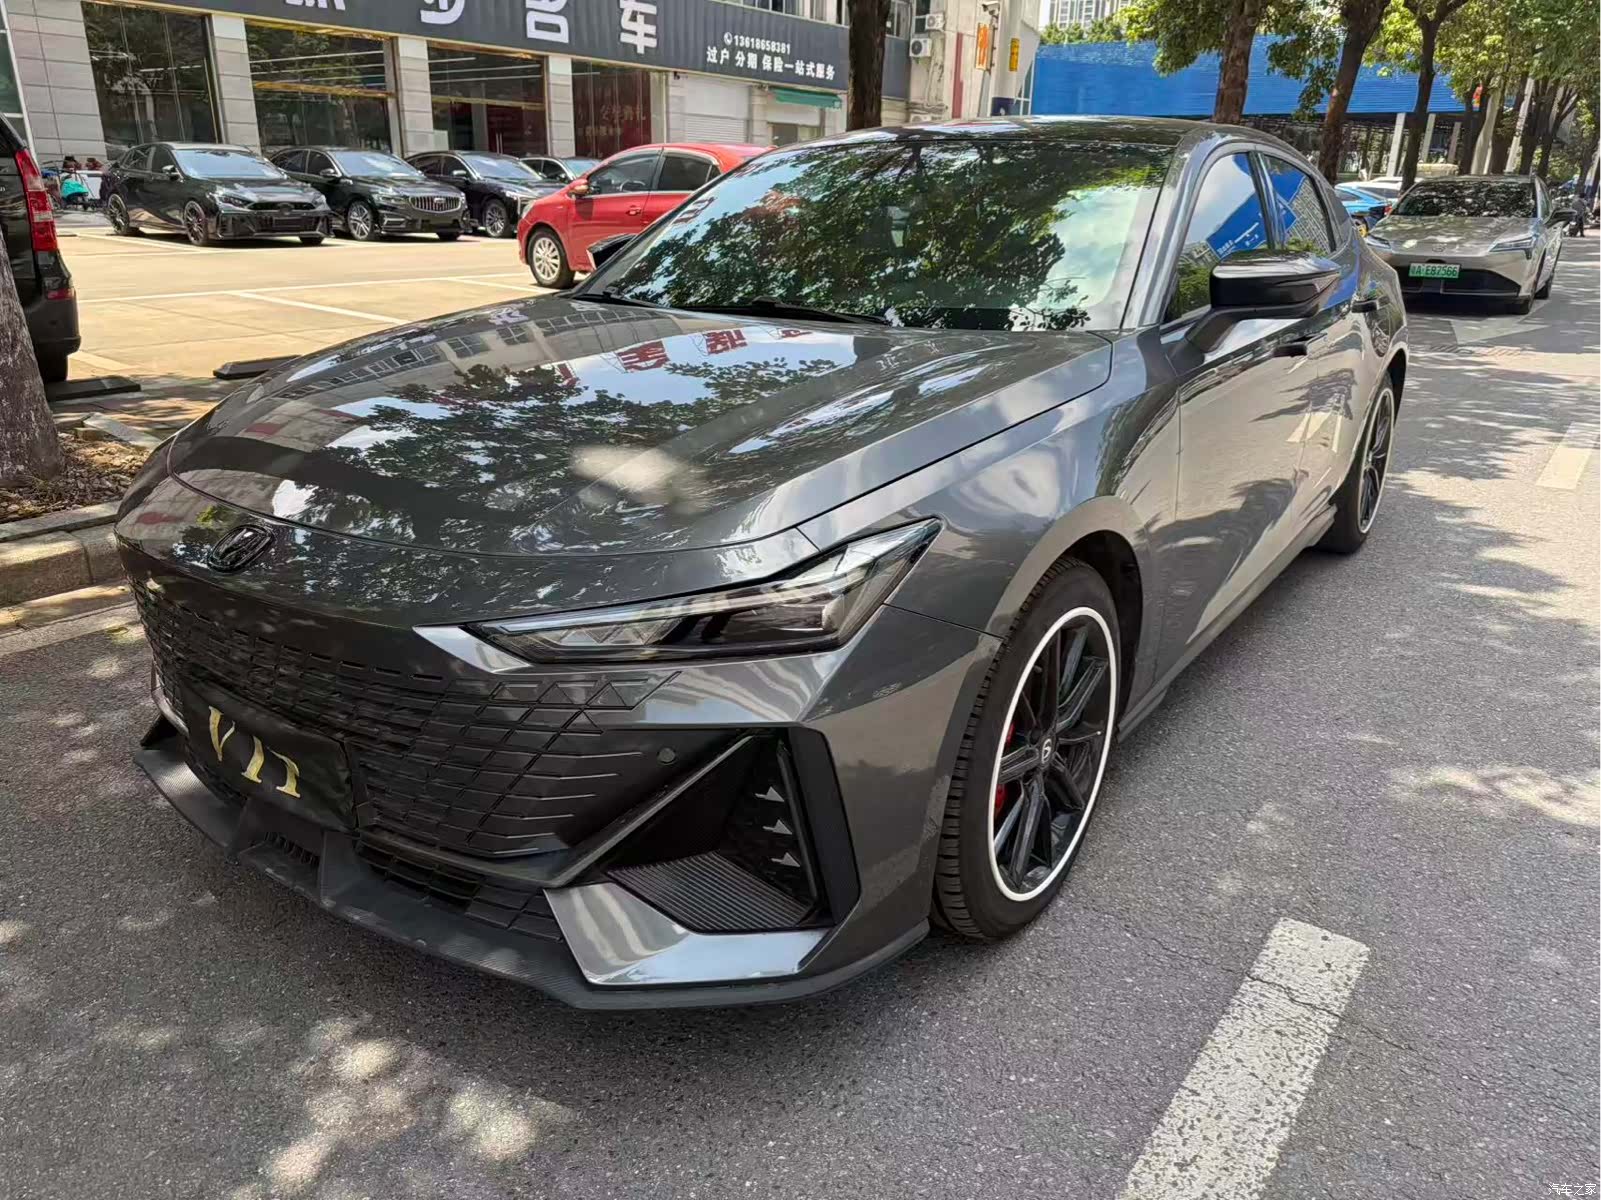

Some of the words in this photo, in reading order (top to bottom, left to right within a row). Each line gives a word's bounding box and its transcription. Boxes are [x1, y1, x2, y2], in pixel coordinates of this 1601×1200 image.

[734, 35, 791, 55] 13618658381
[706, 46, 730, 65] 过户
[735, 51, 758, 69] 分期
[762, 54, 835, 81] 保险一站式服务
